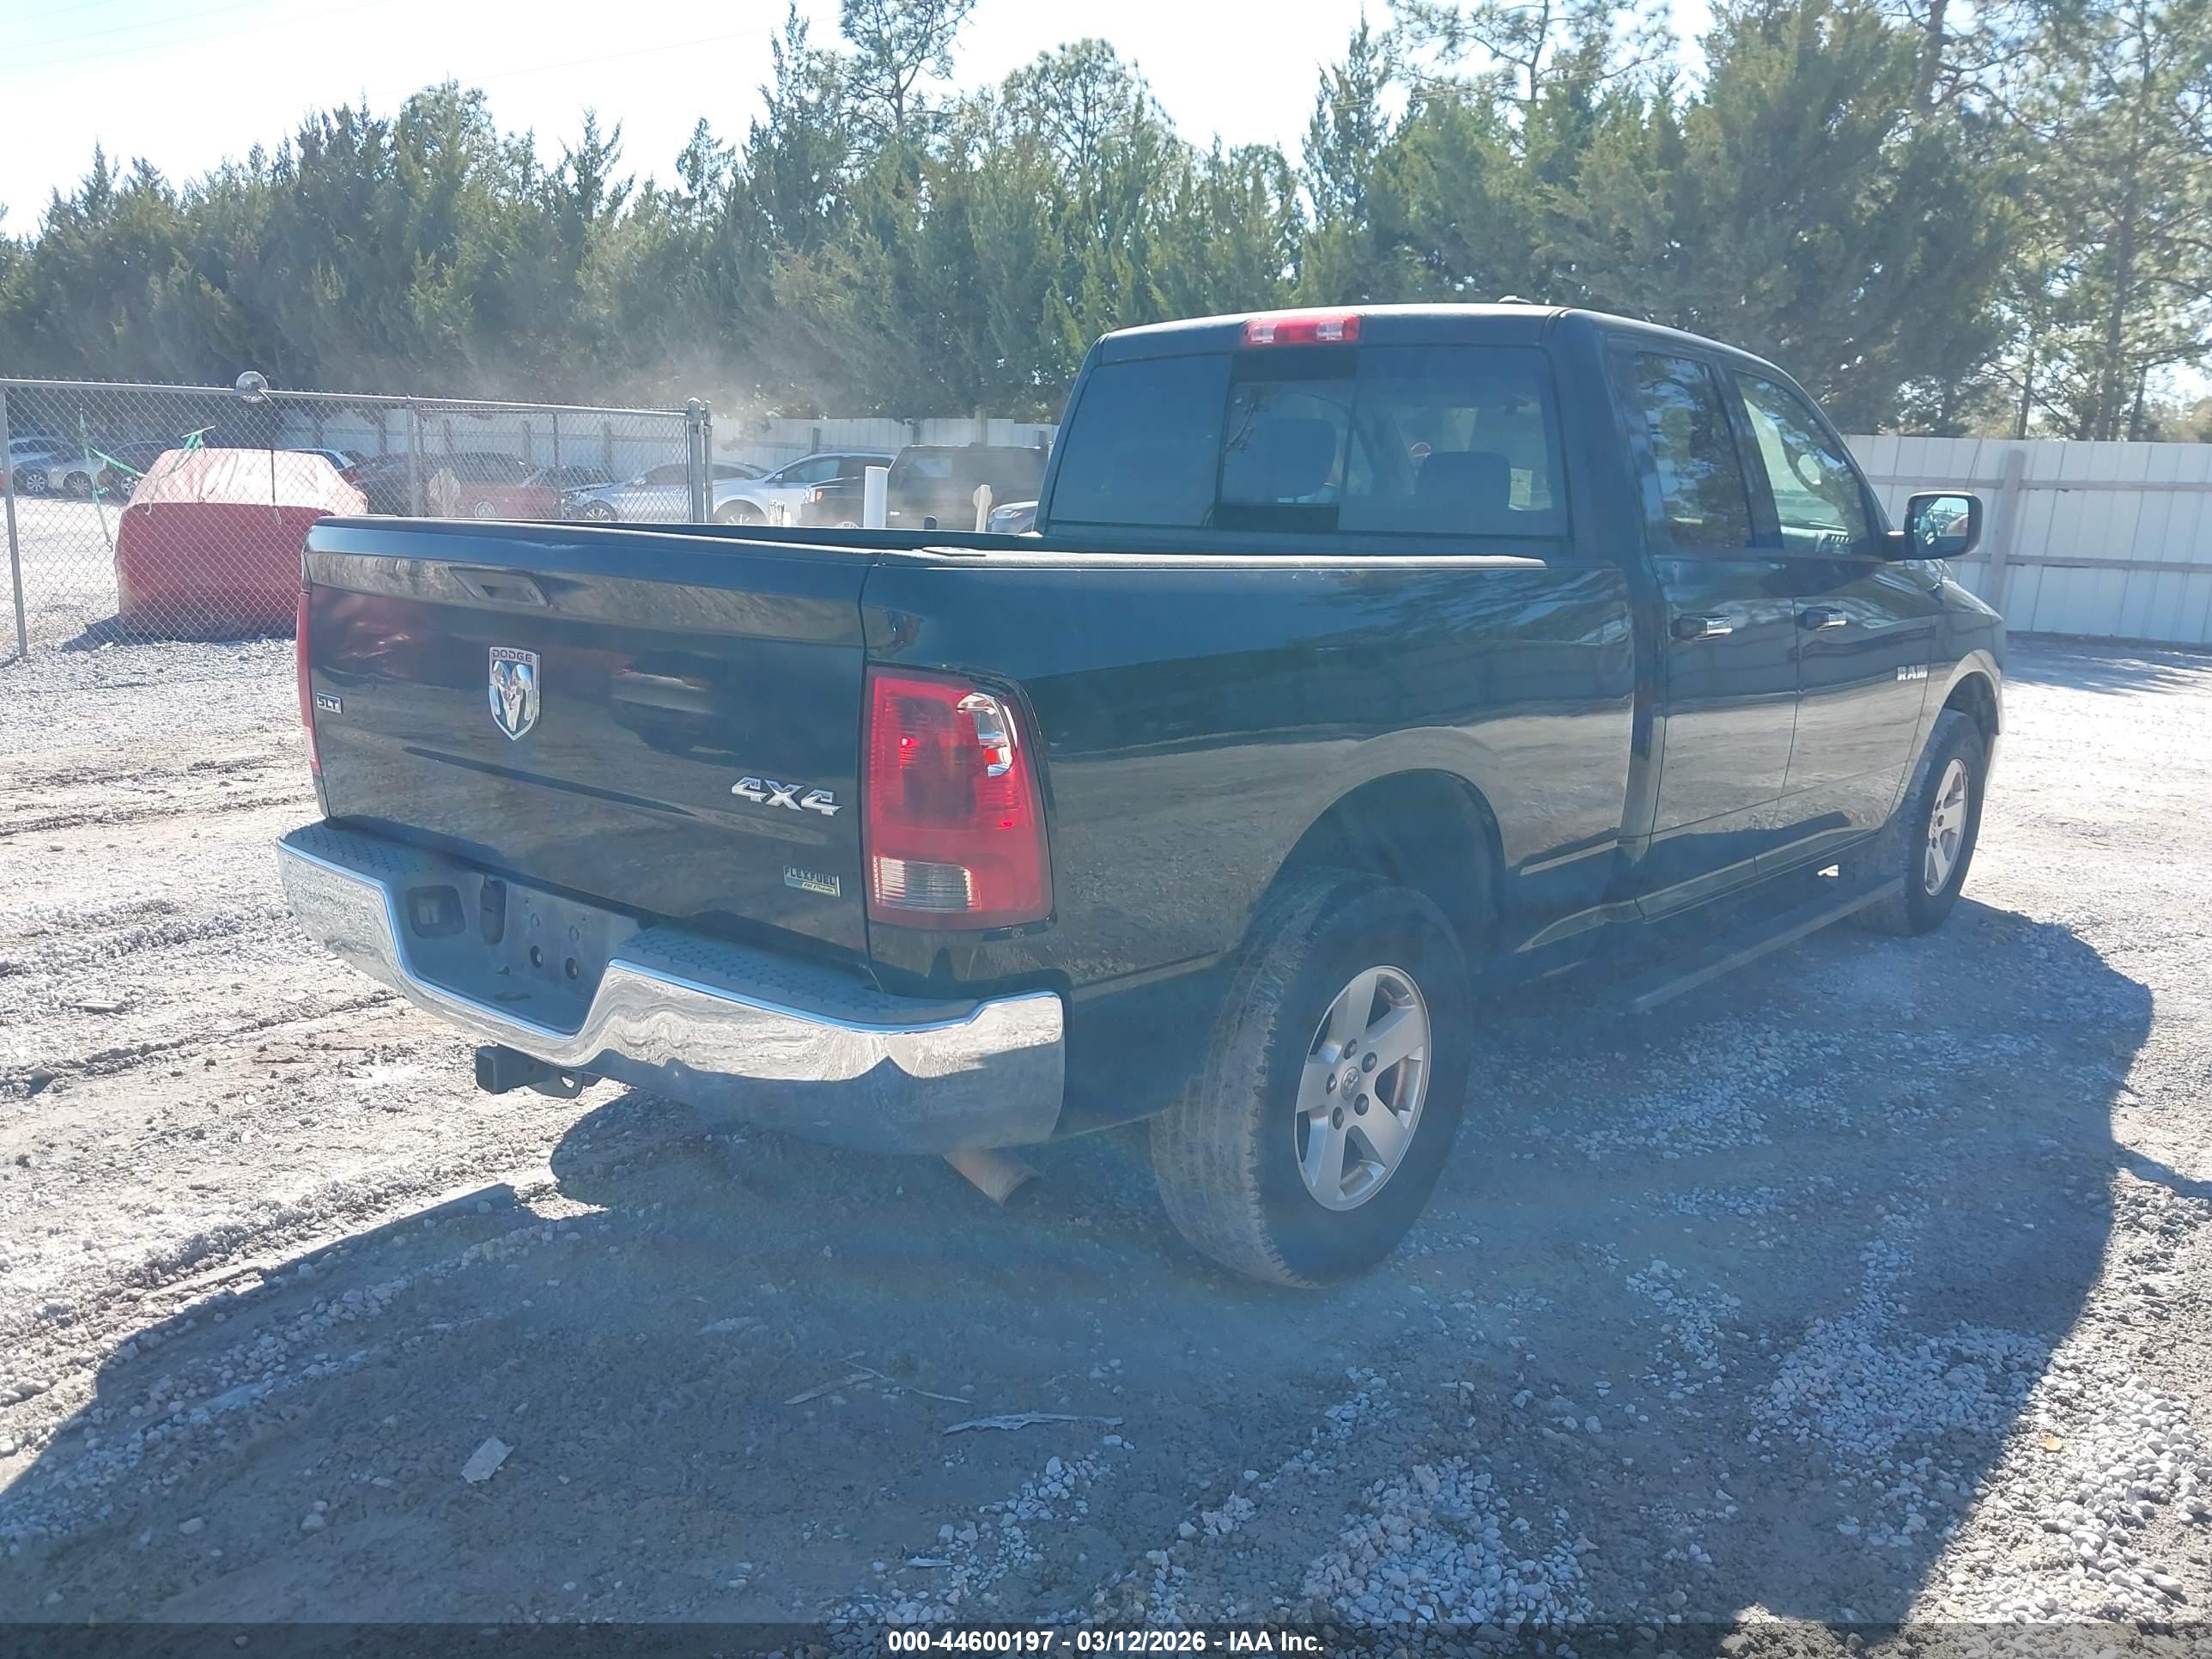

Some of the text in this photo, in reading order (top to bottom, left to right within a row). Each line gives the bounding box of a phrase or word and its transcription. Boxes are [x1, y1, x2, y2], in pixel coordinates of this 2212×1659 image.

[492, 648, 532, 662] DODGE
[1897, 665, 1928, 680] RAM
[319, 696, 339, 710] SLT
